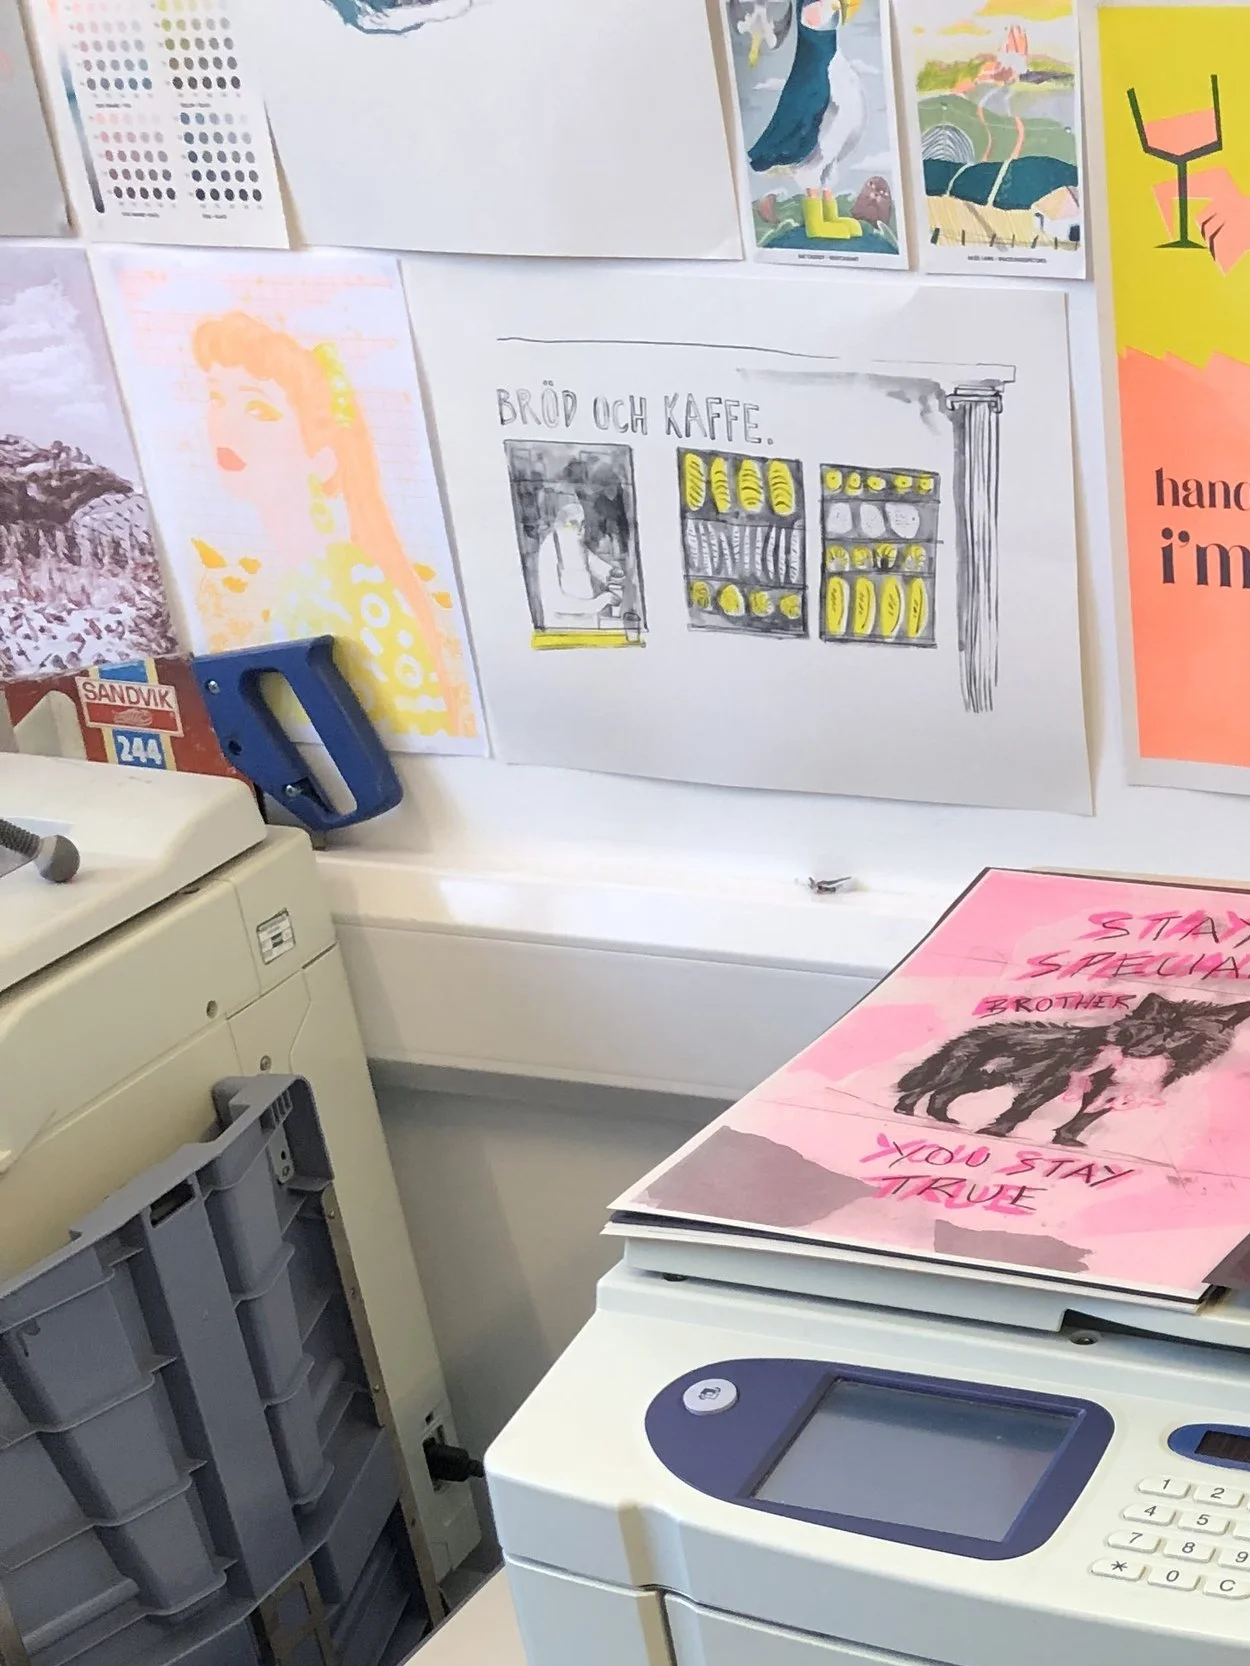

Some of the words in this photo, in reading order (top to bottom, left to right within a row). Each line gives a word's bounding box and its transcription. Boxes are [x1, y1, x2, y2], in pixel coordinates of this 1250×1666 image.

[496, 380, 577, 428] BRÖD
[593, 395, 648, 435] OCH
[82, 681, 173, 709] SANDVIK
[117, 735, 161, 765] 244
[972, 991, 1137, 1018] BROTHER
[859, 1133, 991, 1169] YOU
[994, 1150, 1142, 1190] STAY
[864, 1174, 1048, 1216] TRUE
[1161, 1478, 1171, 1490] 1
[1210, 1487, 1225, 1500] 2
[1144, 1505, 1157, 1517] 4
[1196, 1514, 1211, 1526] 5
[1129, 1532, 1143, 1543] 7
[1181, 1541, 1196, 1554] 8
[1235, 1551, 1249, 1563] 9
[1166, 1569, 1180, 1583] 0
[1219, 1579, 1236, 1593] C
